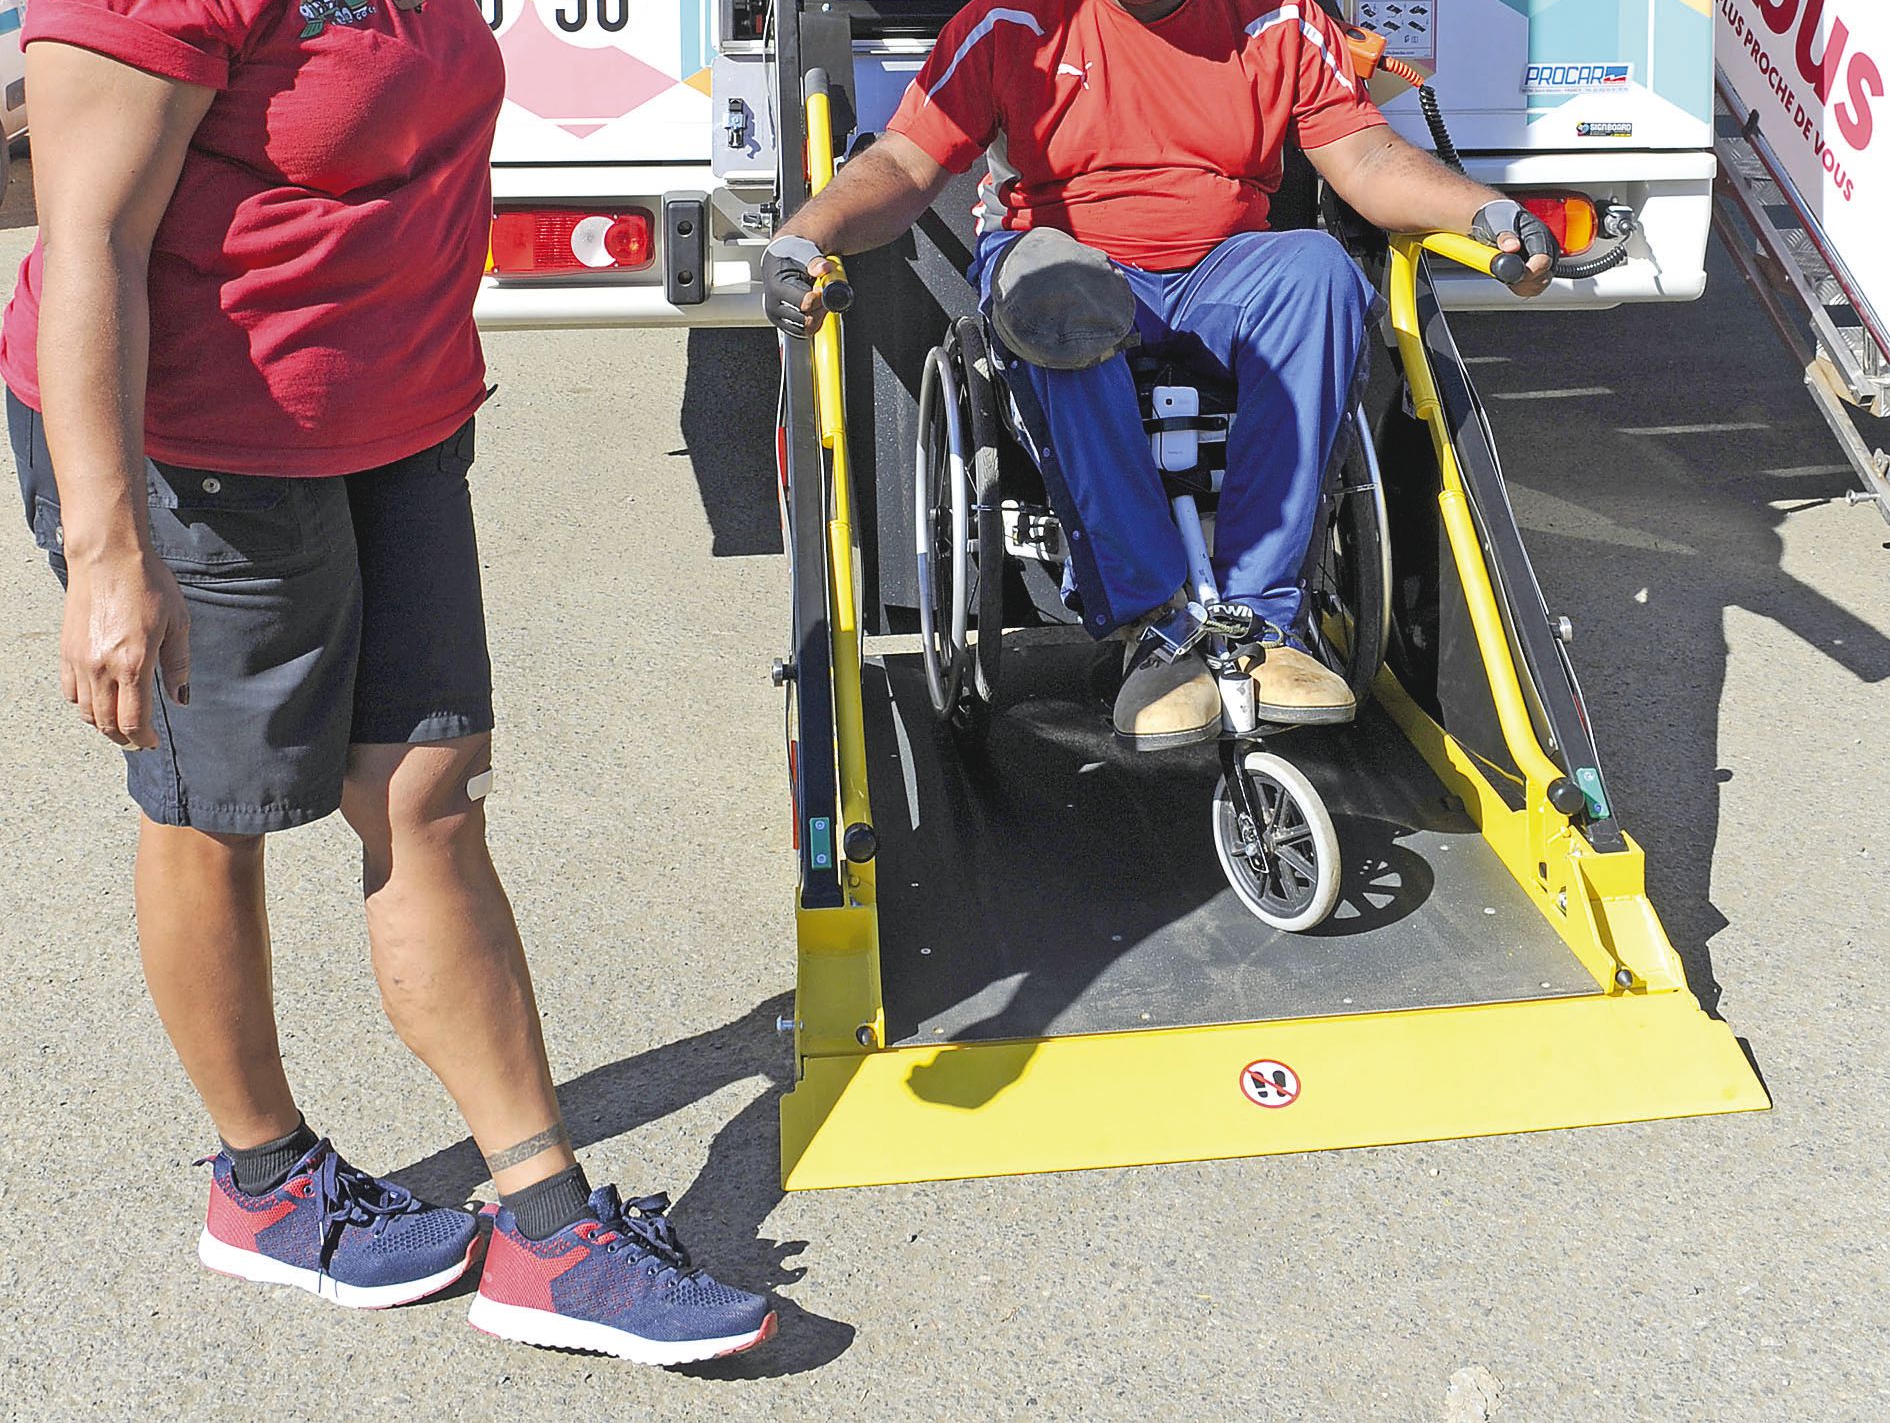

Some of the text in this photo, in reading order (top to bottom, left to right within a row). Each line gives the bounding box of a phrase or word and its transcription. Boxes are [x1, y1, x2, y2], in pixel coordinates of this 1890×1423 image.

[1525, 66, 1605, 85] PROCAR
[1744, 28, 1795, 113] PROCHE
[1793, 104, 1813, 140] DE
[1814, 130, 1854, 201] VOUS
